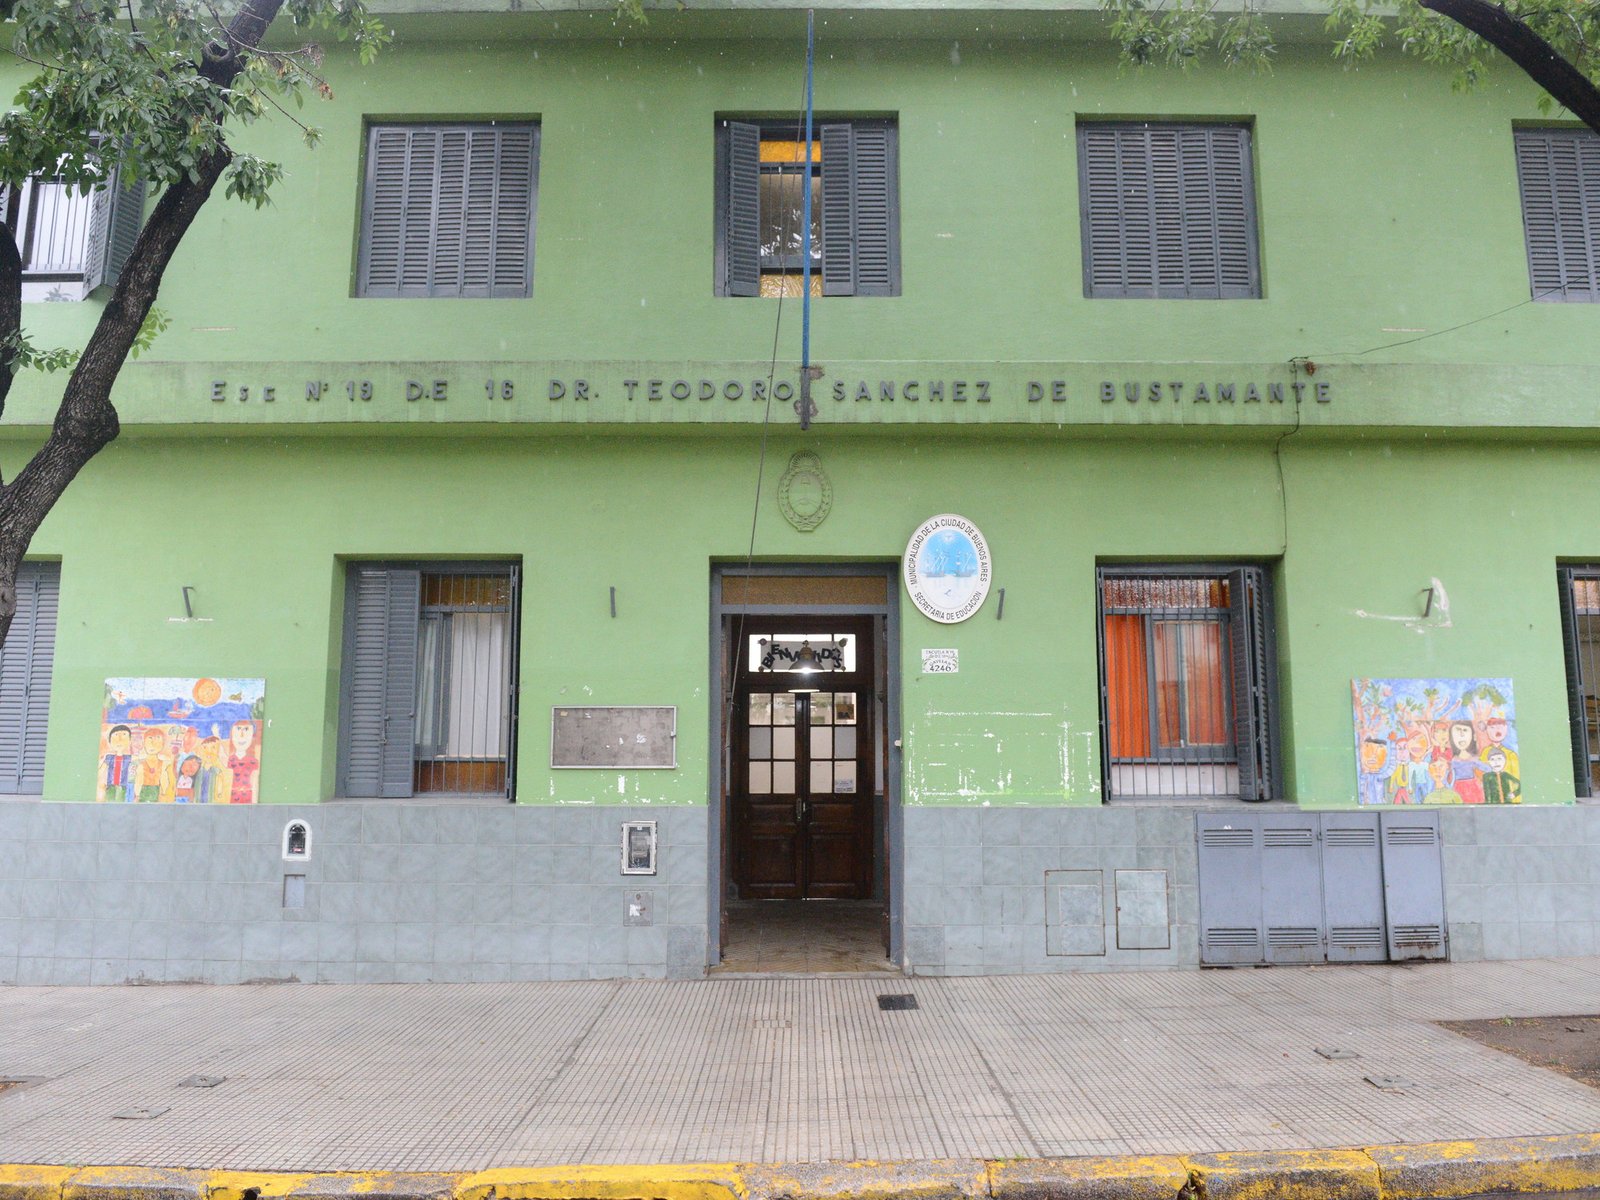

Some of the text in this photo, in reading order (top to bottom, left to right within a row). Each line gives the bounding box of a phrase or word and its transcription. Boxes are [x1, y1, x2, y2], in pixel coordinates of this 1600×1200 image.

[485, 379, 514, 400] 16
[623, 379, 793, 400] TEODORO
[833, 380, 991, 402] SANCHEZ
[1027, 381, 1066, 402] DE
[1100, 381, 1331, 404] BUSTAMANTE
[908, 534, 924, 585] MUNICIPALIDAD
[941, 518, 966, 530] CIUDAD
[971, 533, 987, 561] BUENOS
[980, 561, 988, 583] AIRES
[914, 590, 982, 620] SECRETARIA DE EDUCACION
